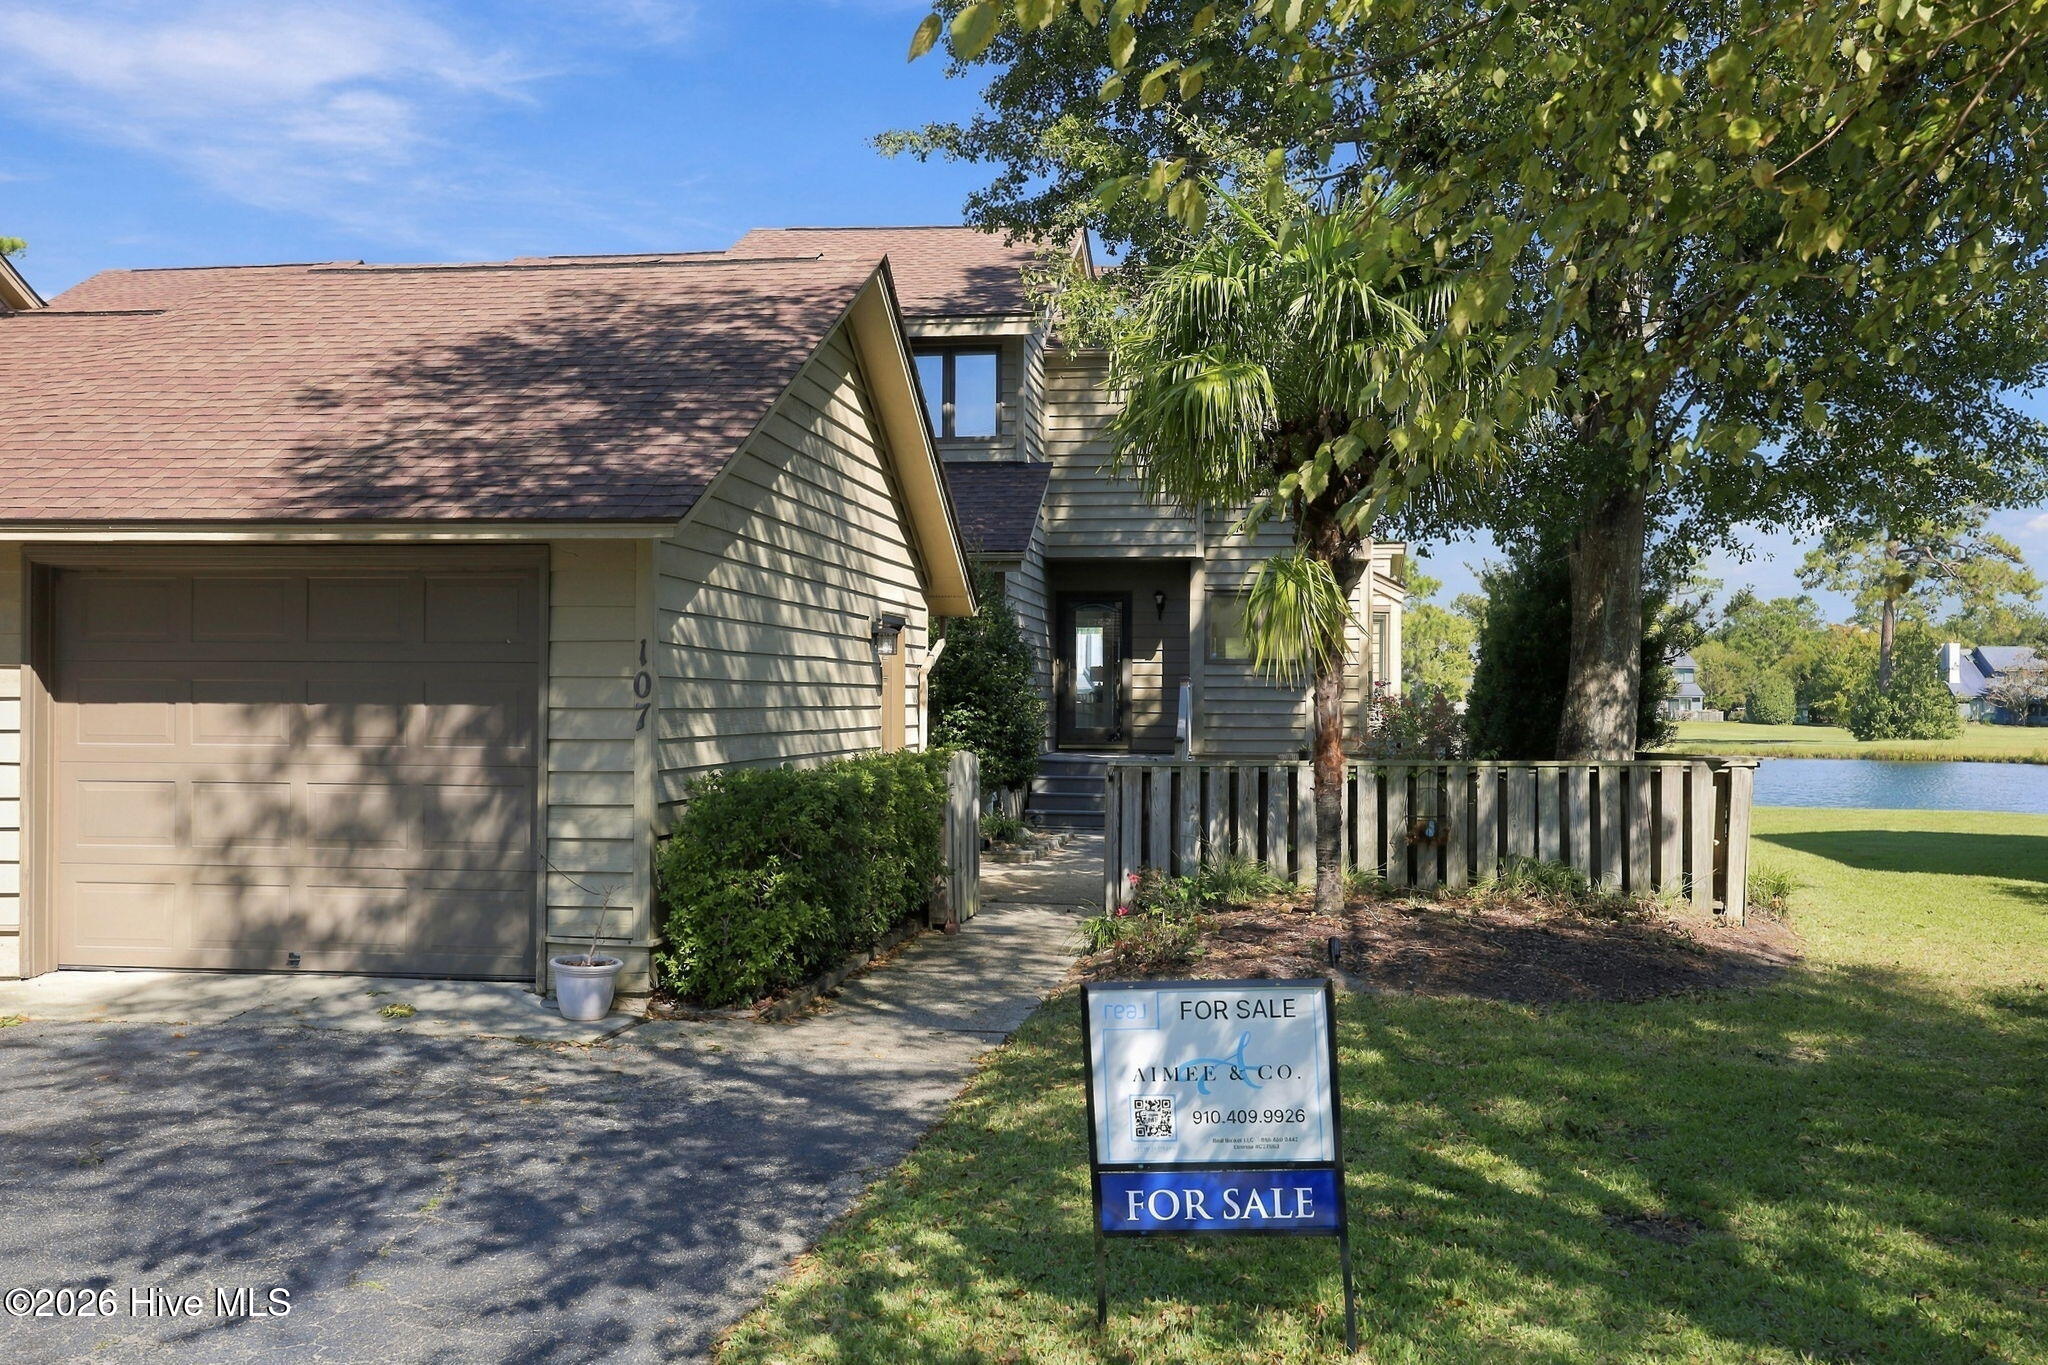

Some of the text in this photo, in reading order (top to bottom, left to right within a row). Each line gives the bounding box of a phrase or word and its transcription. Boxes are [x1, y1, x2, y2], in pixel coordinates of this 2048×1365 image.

[633, 638, 652, 732] 107
[1180, 998, 1297, 1020] FOR SALE
[1133, 1064, 1302, 1082] AIMEE & CO.
[1192, 1108, 1306, 1125] 910.409.9926
[1125, 1187, 1315, 1221] FOR SALE
